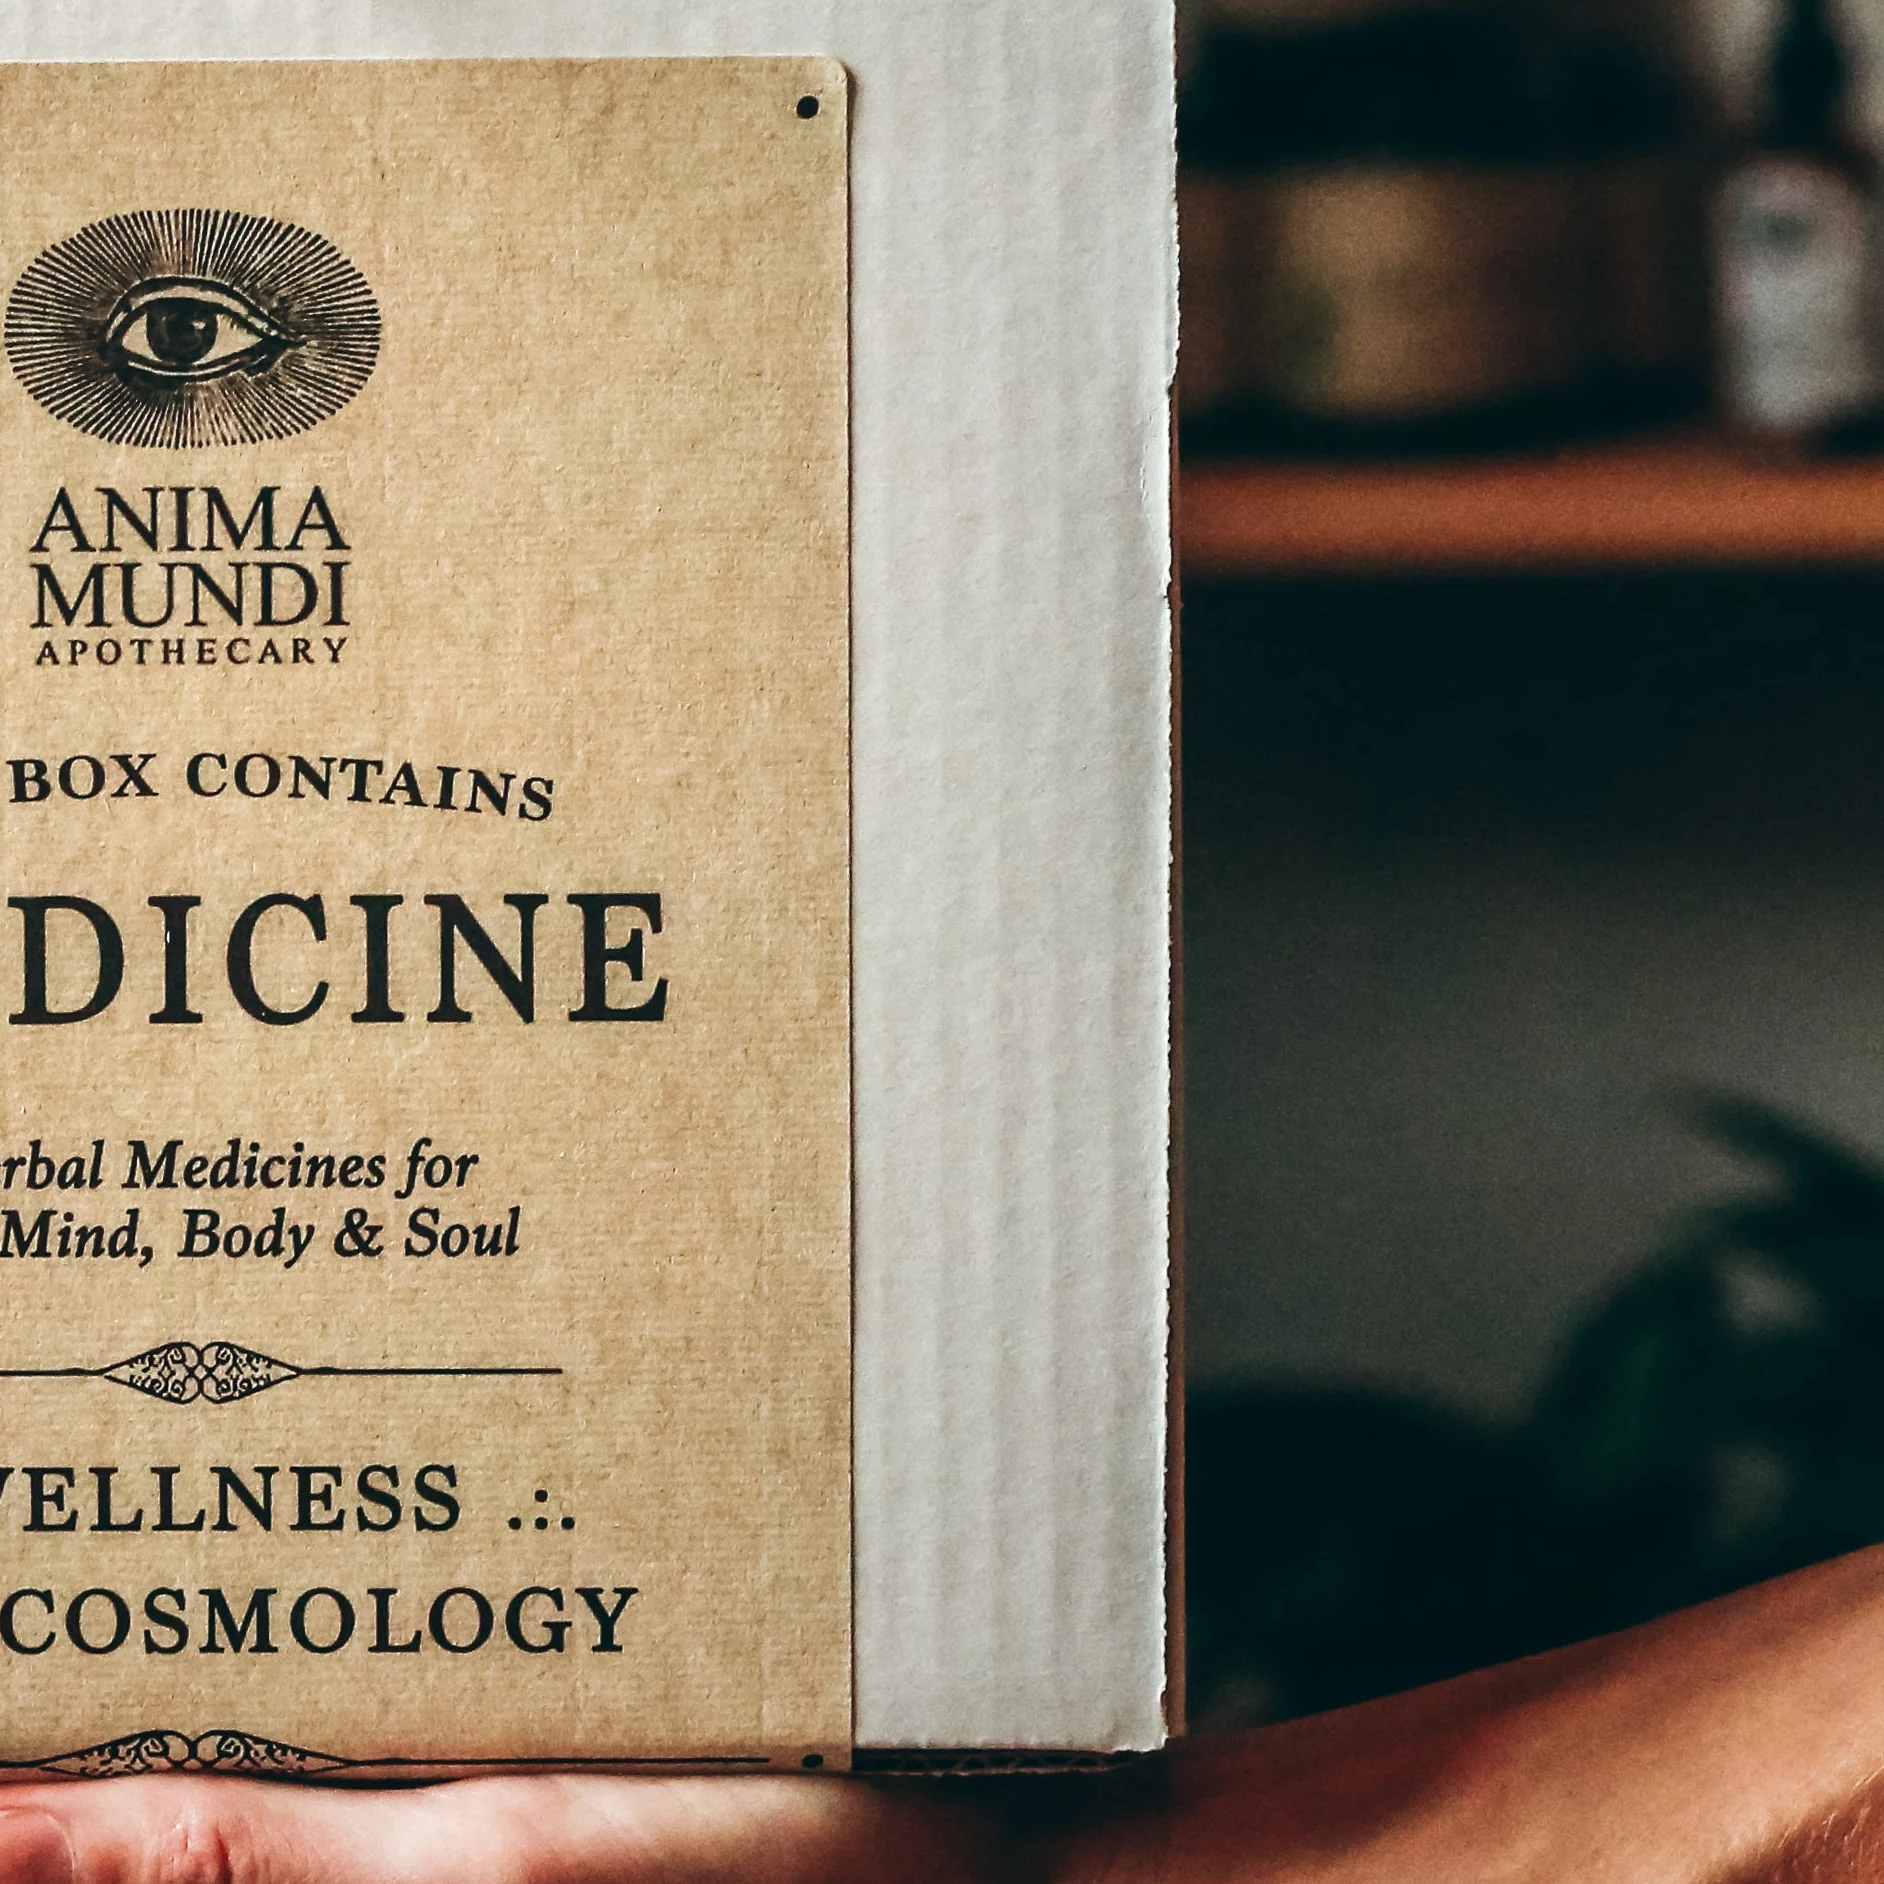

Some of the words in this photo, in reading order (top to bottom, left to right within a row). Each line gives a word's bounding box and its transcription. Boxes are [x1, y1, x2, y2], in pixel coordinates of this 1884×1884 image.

[28, 484, 353, 554] ANIMA
[29, 560, 352, 630] MUNDI
[34, 636, 348, 667] APOTHECARY
[4, 752, 160, 804] BOX
[185, 751, 555, 823] CONTAINS
[120, 1136, 387, 1191] Medicines
[393, 1136, 481, 1201] for
[176, 1205, 316, 1271] Body
[332, 1206, 385, 1259] &
[403, 1204, 522, 1259] Soul
